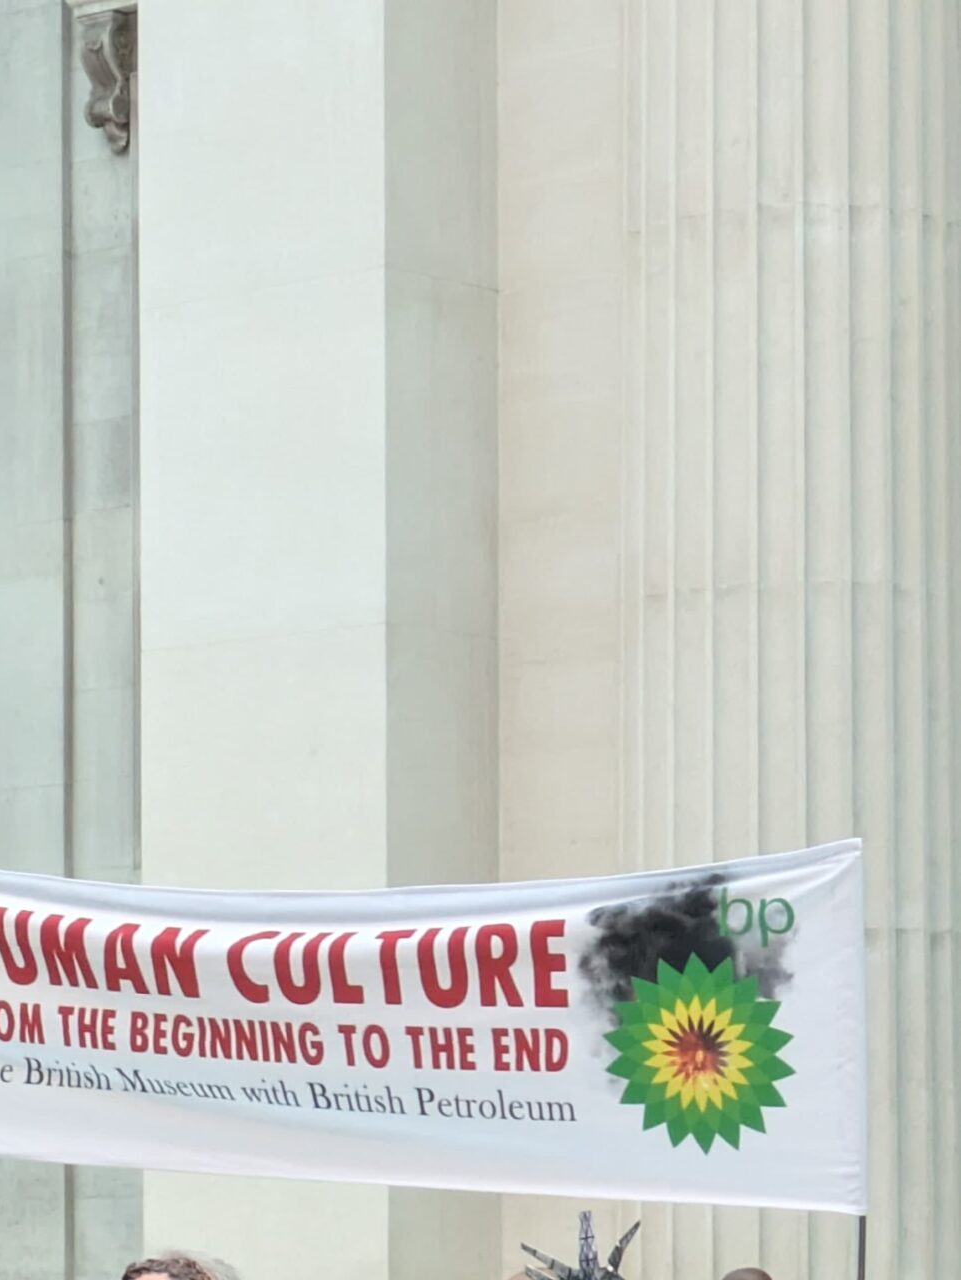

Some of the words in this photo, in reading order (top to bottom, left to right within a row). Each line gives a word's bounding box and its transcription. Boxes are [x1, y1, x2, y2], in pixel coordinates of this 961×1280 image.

[717, 888, 795, 947] bp
[226, 919, 569, 1008] CULTURE
[58, 1005, 117, 1051] THE
[129, 1011, 324, 1066] BEGINNING
[338, 1023, 390, 1069] TO
[404, 1026, 477, 1071] THE
[493, 1028, 569, 1073] END
[24, 1056, 113, 1092] British
[115, 1067, 236, 1101] Museum
[241, 1079, 301, 1109] with
[307, 1082, 406, 1115] British
[416, 1087, 577, 1122] Petroleum
